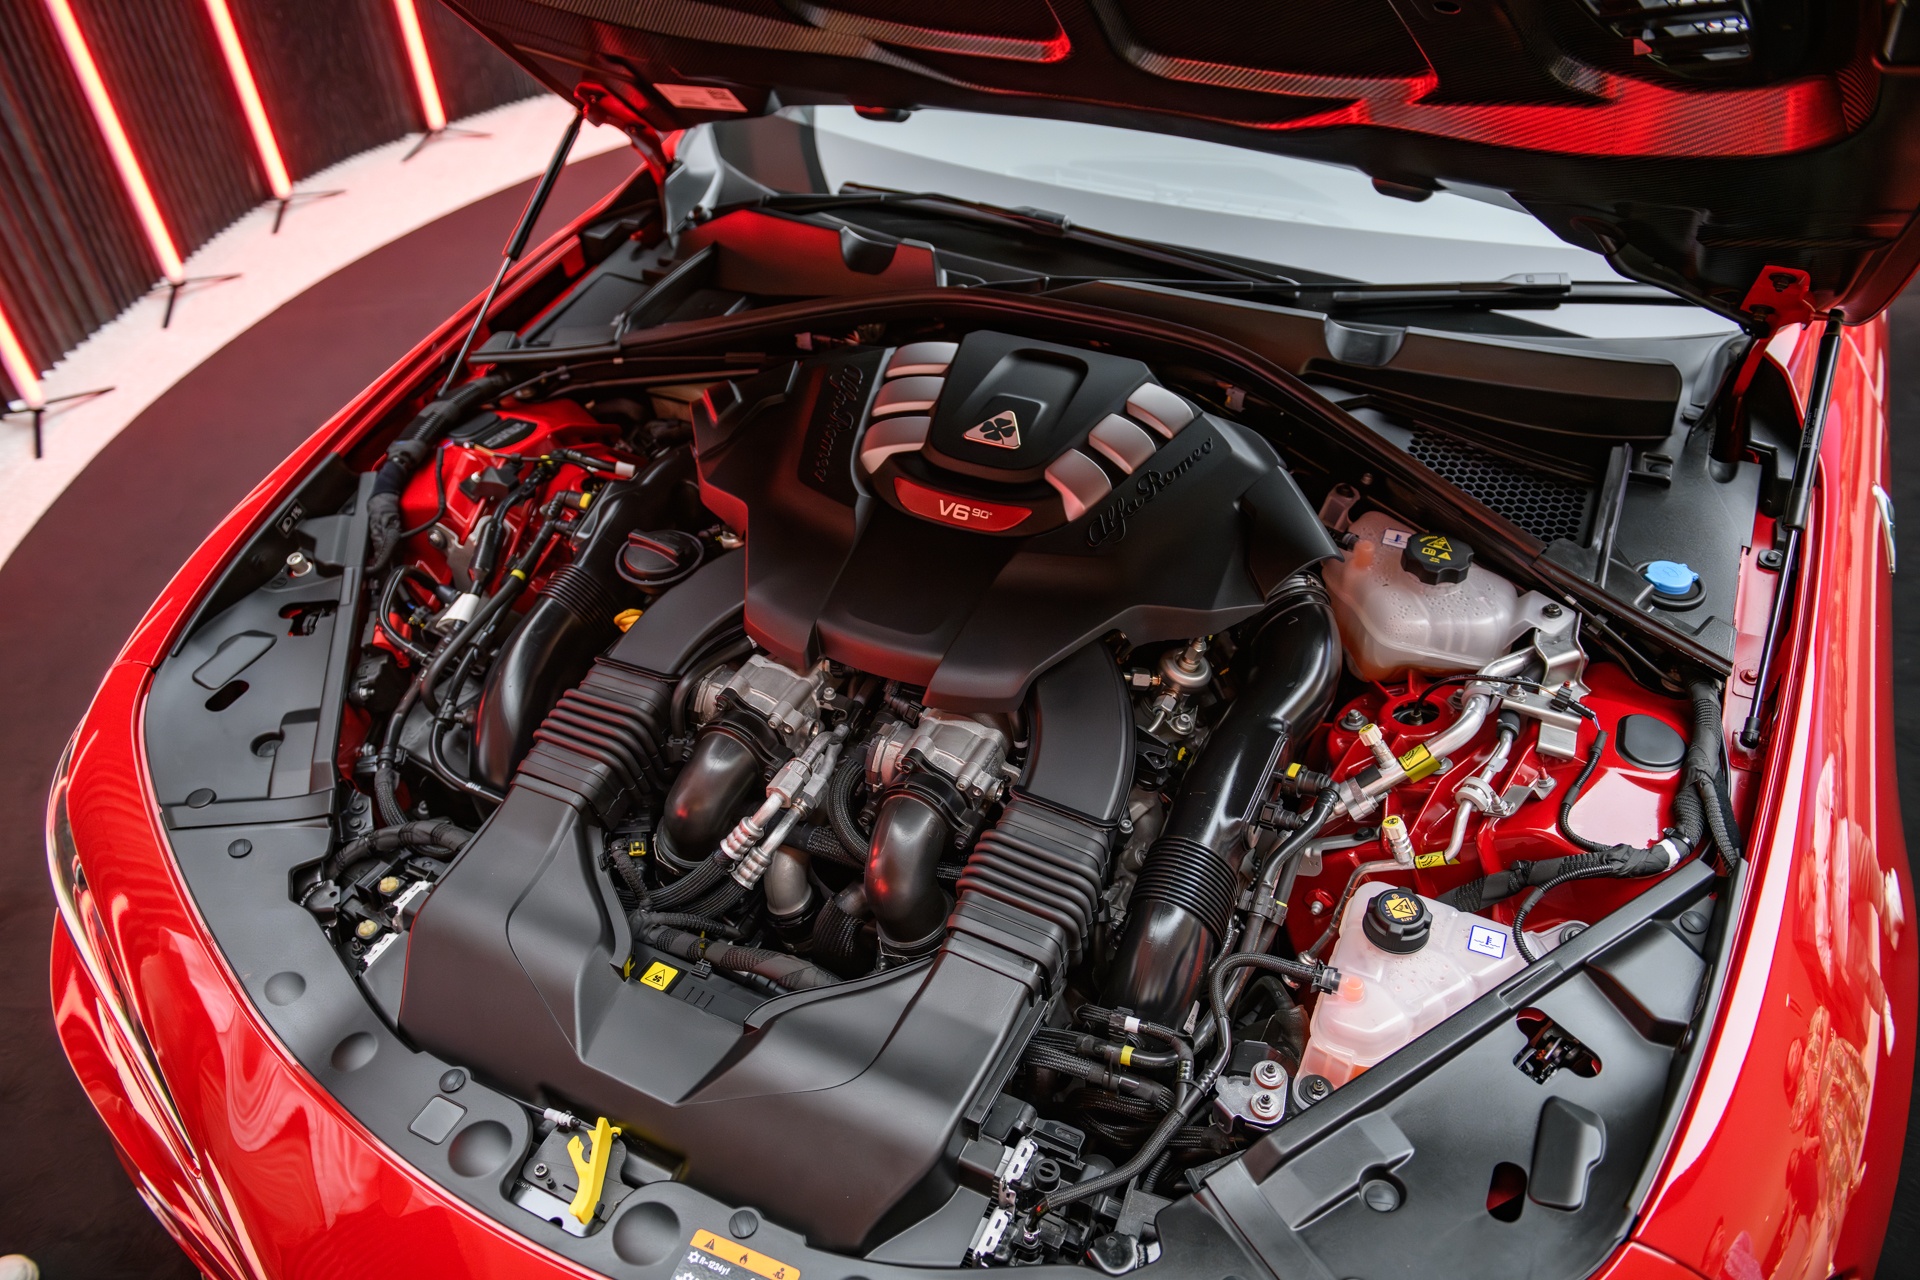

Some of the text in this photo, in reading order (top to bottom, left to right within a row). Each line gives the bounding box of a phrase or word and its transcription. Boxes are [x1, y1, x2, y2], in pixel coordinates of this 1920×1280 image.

[814, 366, 864, 482] Alfa Romeo
[939, 499, 971, 521] V6
[1087, 436, 1213, 547] Alfa Romeo
